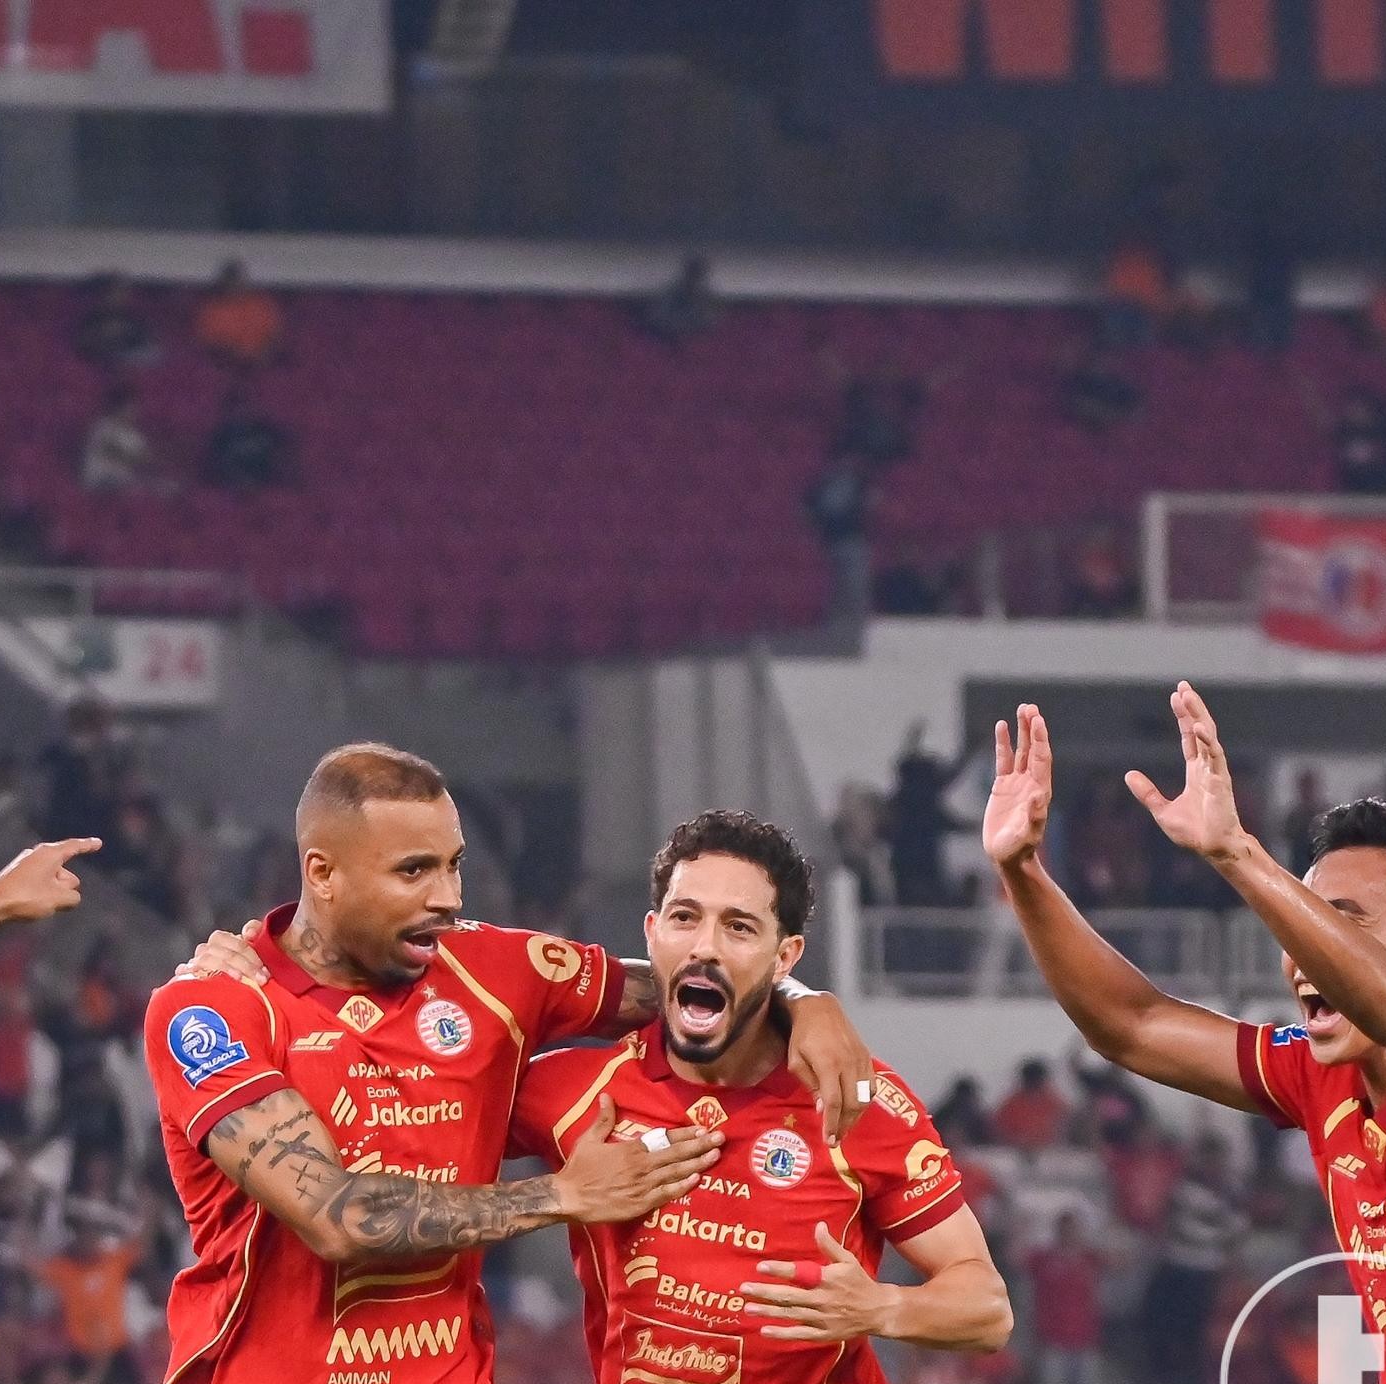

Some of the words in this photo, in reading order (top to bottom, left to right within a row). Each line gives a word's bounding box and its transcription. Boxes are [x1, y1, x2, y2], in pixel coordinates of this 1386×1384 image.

[358, 1062, 392, 1079] PAM
[366, 1086, 401, 1099] Bank
[363, 1099, 463, 1128] Jakarta
[769, 1133, 803, 1147] PERSIJA
[698, 1175, 752, 1200] JAYA
[643, 1208, 767, 1251] Jakarta
[656, 1273, 745, 1313] Bakrie
